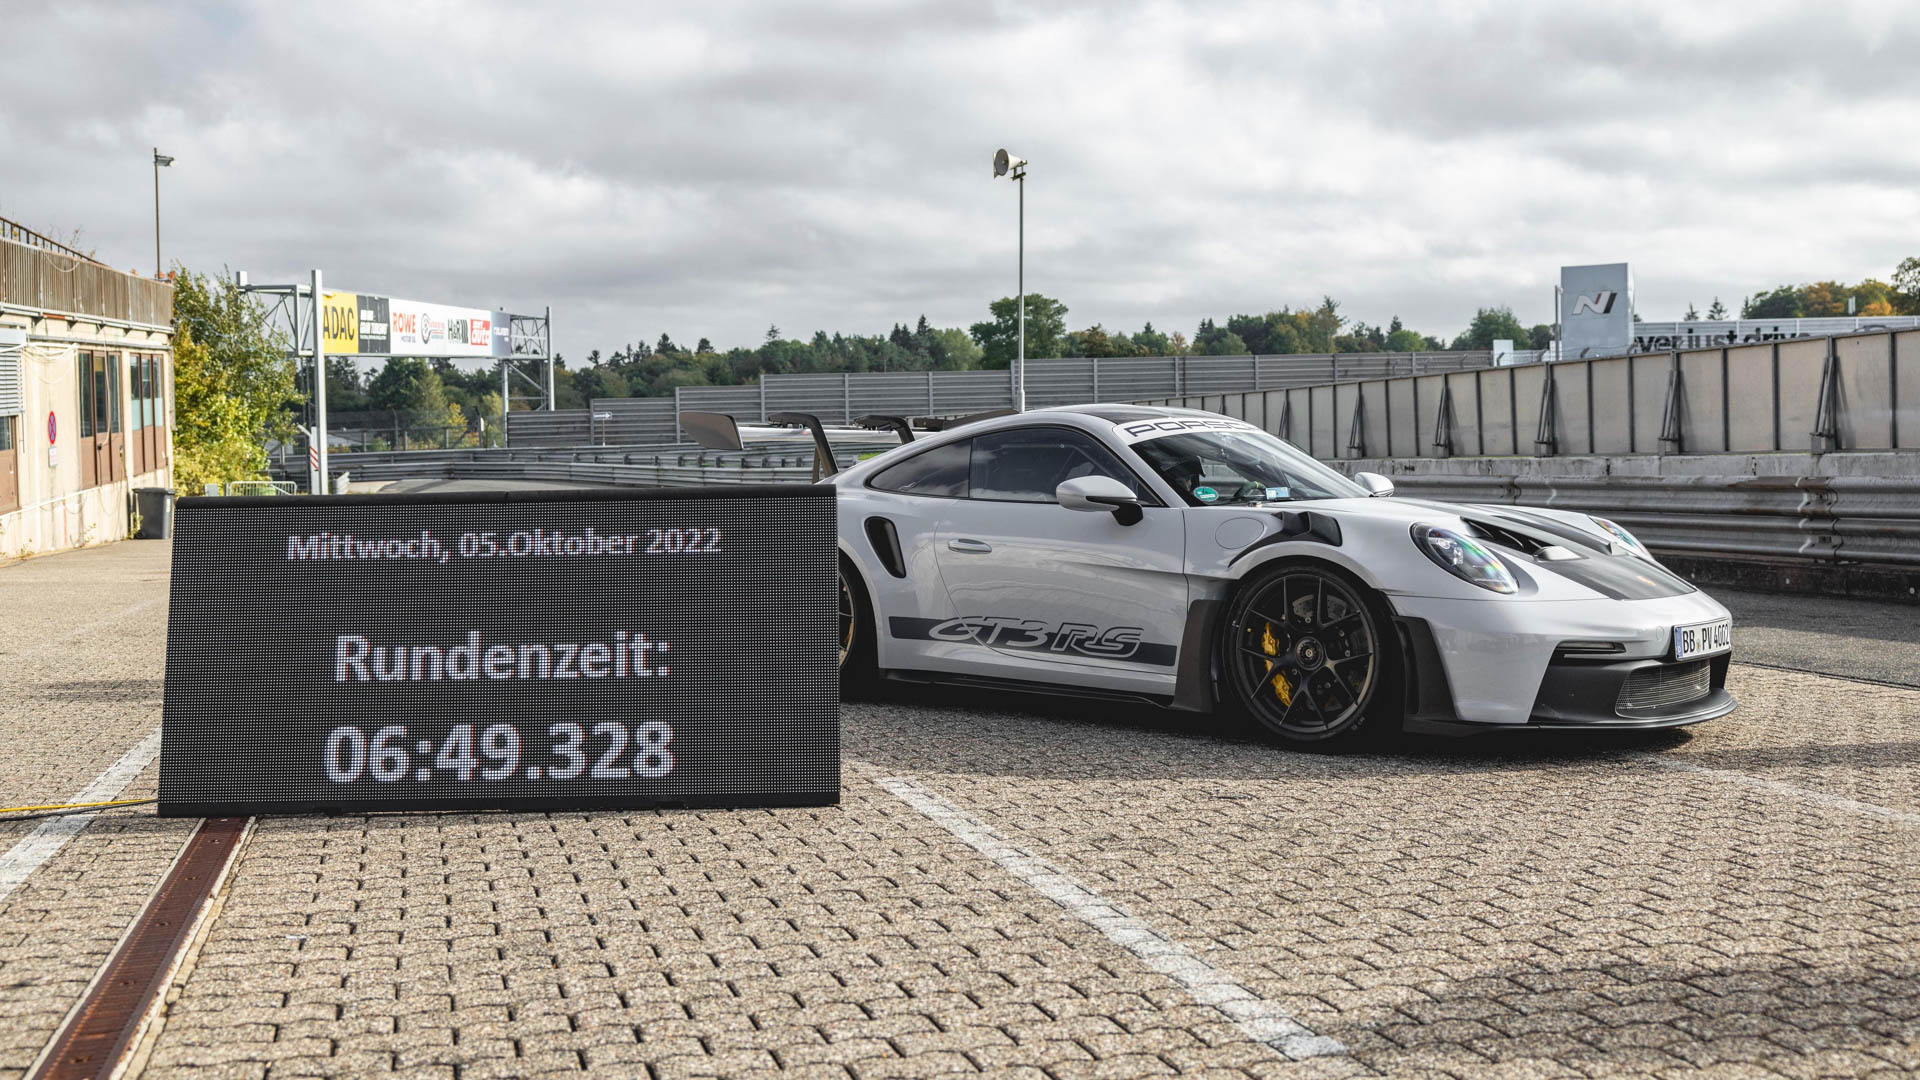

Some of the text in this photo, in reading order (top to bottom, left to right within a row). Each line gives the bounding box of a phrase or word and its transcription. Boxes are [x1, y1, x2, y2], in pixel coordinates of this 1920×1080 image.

[323, 305, 354, 340] ADAC
[393, 312, 416, 334] ROWE
[287, 527, 722, 563] Mittwoch, 05.Oktober 2022
[929, 615, 1145, 659] GT3 RS
[1683, 630, 1695, 653] BB
[1702, 627, 1712, 650] PV
[335, 631, 672, 683] Rundenzeit:
[323, 722, 678, 783] 06:49.328
